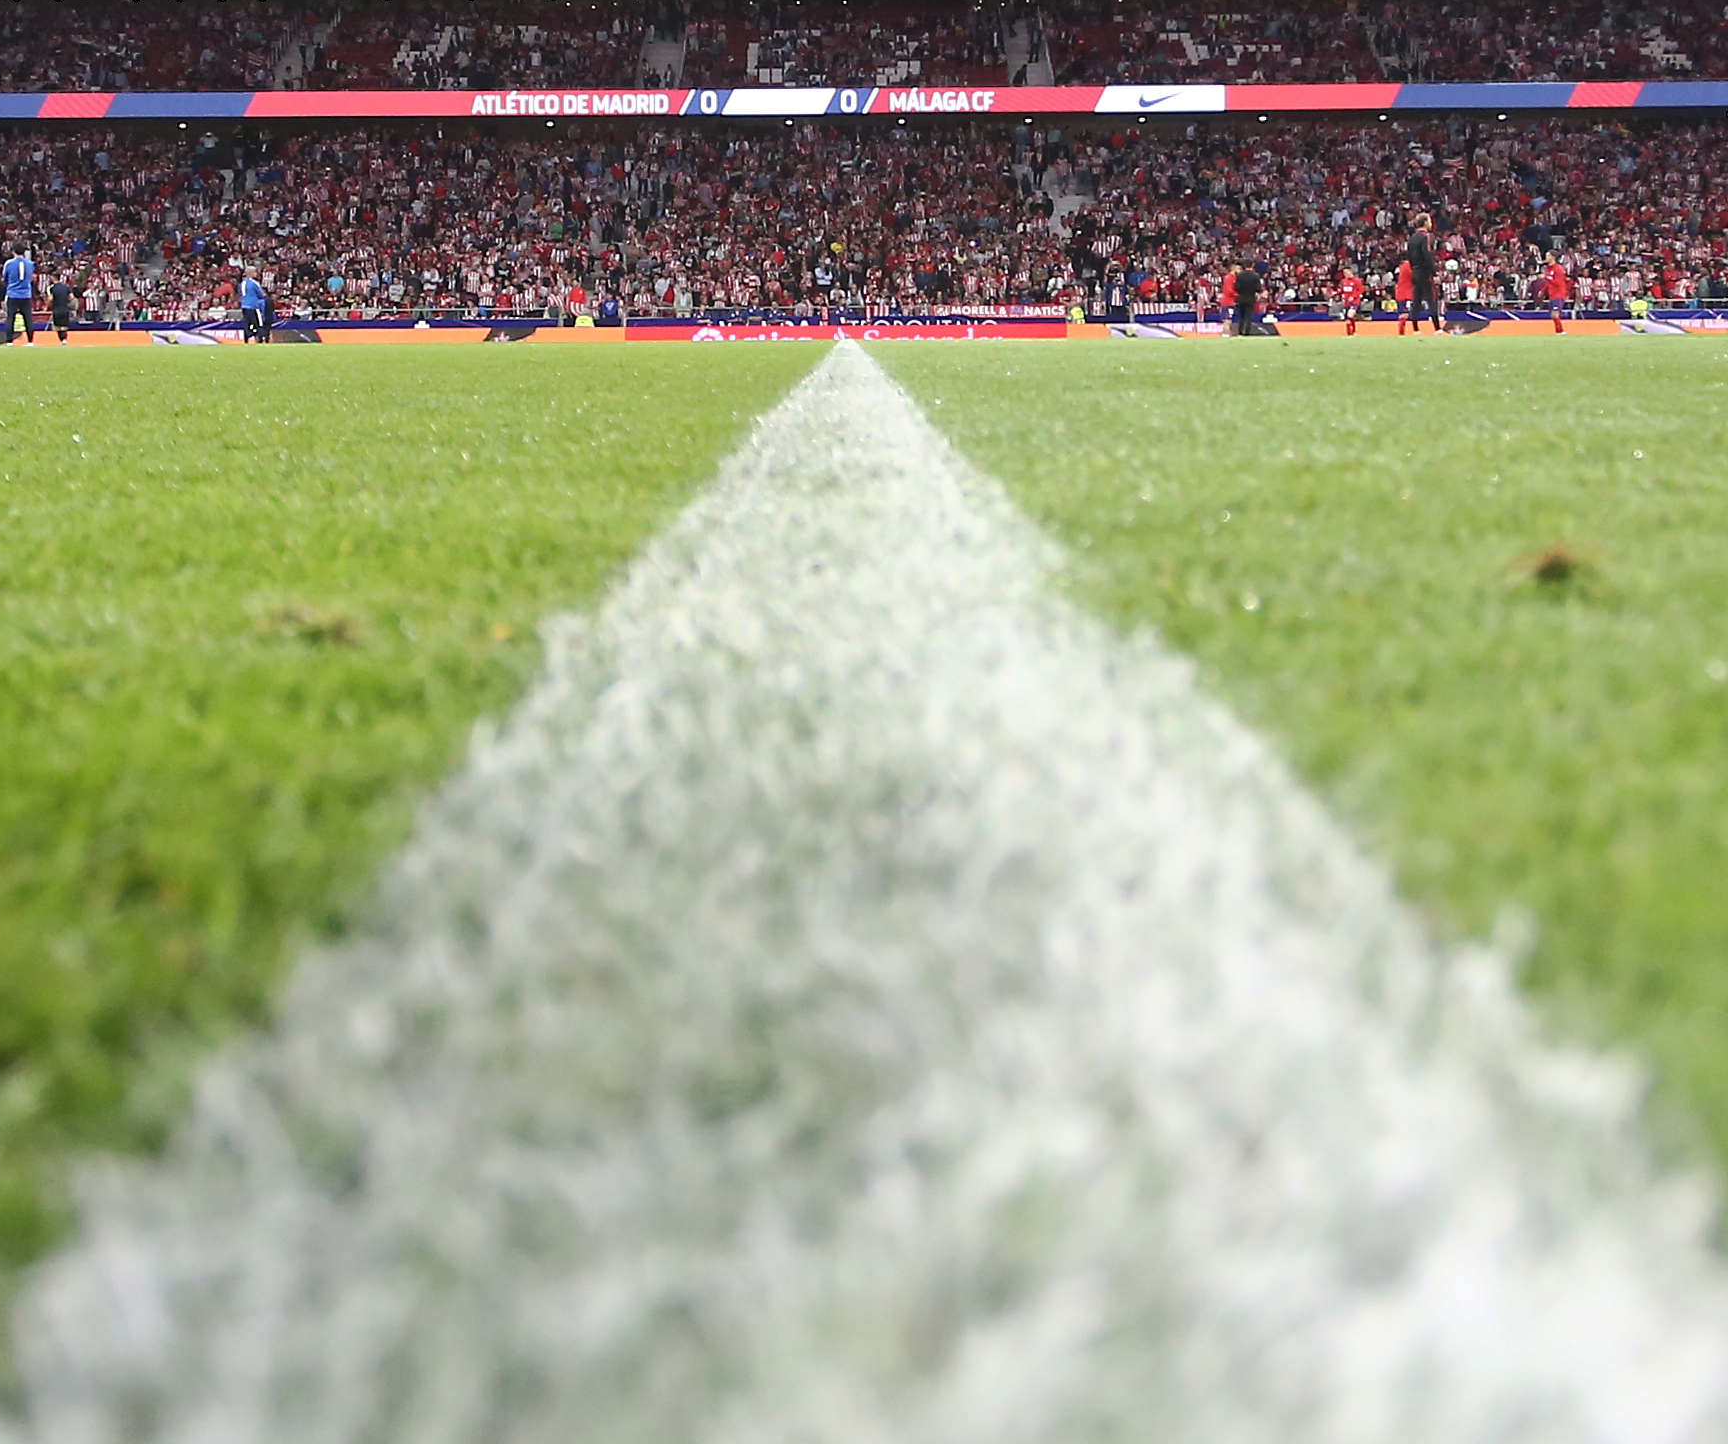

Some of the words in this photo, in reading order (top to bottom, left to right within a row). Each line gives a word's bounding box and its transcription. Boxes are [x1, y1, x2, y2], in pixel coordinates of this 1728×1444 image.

[472, 90, 560, 115] ATLÉTICO
[563, 93, 589, 115] DE
[592, 93, 670, 115] MADRID
[700, 90, 718, 114] 0
[840, 89, 858, 113] 0
[888, 87, 971, 112] MÁLAGA
[972, 90, 995, 112] CF
[951, 305, 997, 316] MORELL
